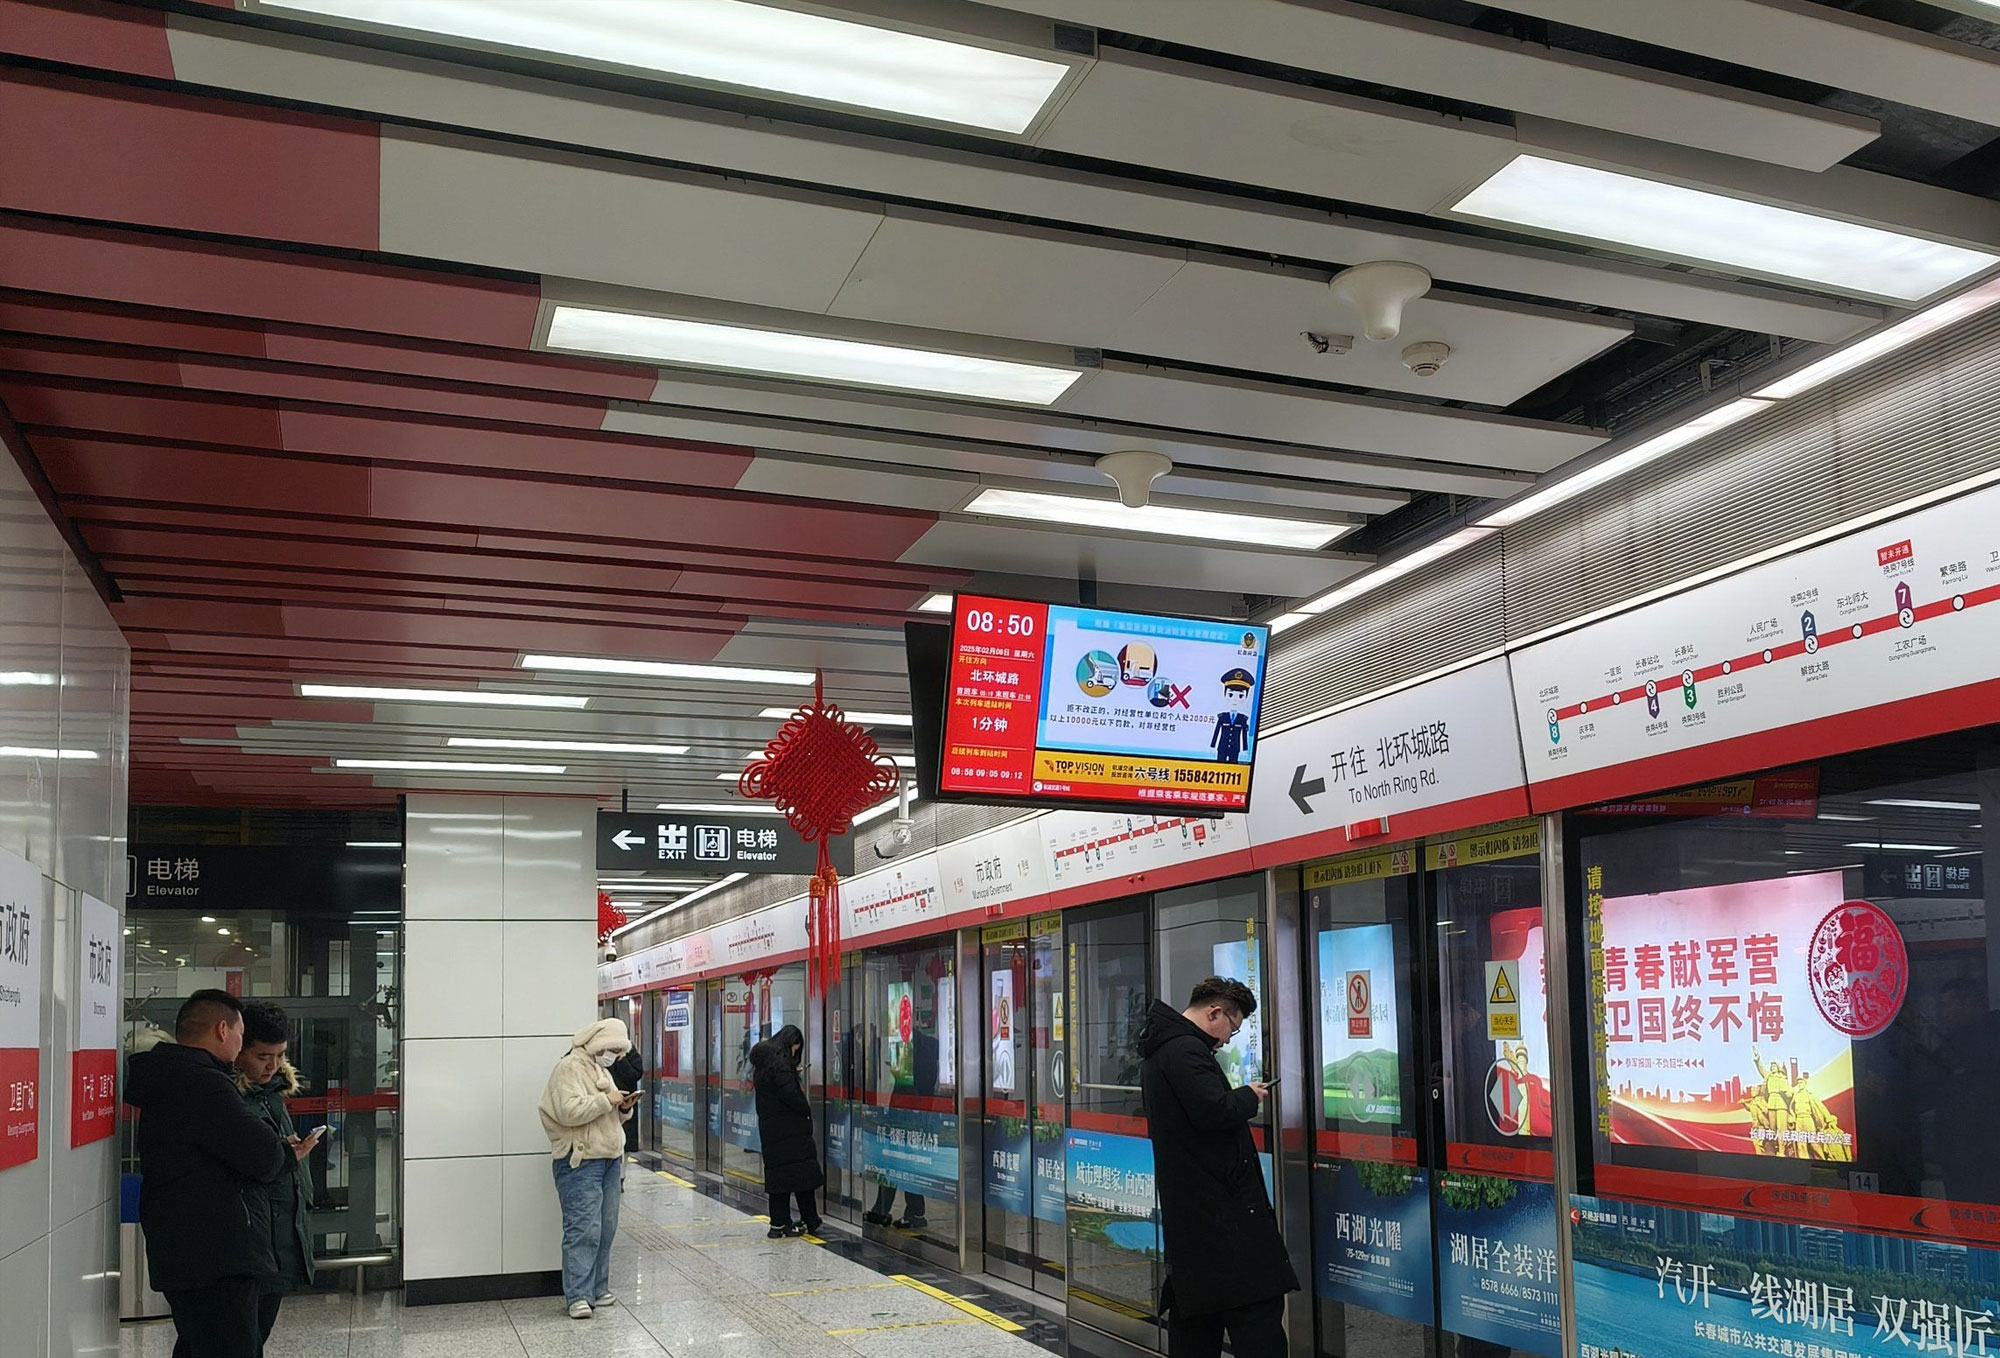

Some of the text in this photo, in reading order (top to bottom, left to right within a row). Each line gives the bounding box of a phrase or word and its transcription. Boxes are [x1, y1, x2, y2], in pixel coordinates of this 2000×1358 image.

[1880, 545, 1910, 561] 暂未开通
[1940, 561, 1967, 577] 繁荣路
[1837, 591, 1869, 609] 东北师大
[1898, 589, 1907, 603] 7
[967, 610, 1034, 636] 08:50
[1750, 618, 1778, 635] 人民广场
[1804, 616, 1813, 632] 2
[1895, 635, 1927, 652] 工农广场
[958, 655, 987, 665] 开往方向
[1014, 649, 1034, 659] 星期六
[970, 669, 1019, 685] 北环城路
[1801, 661, 1829, 676] 解放大路
[1687, 690, 1694, 702] 3
[1651, 699, 1657, 712] 4
[972, 716, 1008, 733] 1分钟
[1551, 726, 1558, 738] 8
[1331, 719, 1450, 783] 开往 北环城路
[976, 769, 998, 778] 09:05
[1000, 772, 1023, 780] 09:12
[1055, 760, 1105, 772] TOP VISION
[1135, 767, 1242, 785] 六号线 15584211711
[1349, 767, 1440, 804] To North Ring Rd.
[658, 824, 778, 849] 出 电梯
[658, 850, 777, 860] EXIT Elevator
[147, 858, 200, 881] 电梯
[975, 856, 1002, 884] 市政府
[147, 885, 199, 896] Elevator
[89, 933, 111, 987] 市政府
[1605, 932, 1779, 992] 青春献军营
[1607, 990, 1784, 1043] 卫国终不悔
[1855, 1174, 1872, 1190] 14
[1450, 1232, 1558, 1284] 湖居全装洋
[1481, 1278, 1499, 1293] 8578
[1543, 1290, 1558, 1305] 1111
[1656, 1255, 1997, 1358] 汽开一线湖居 双强匠
